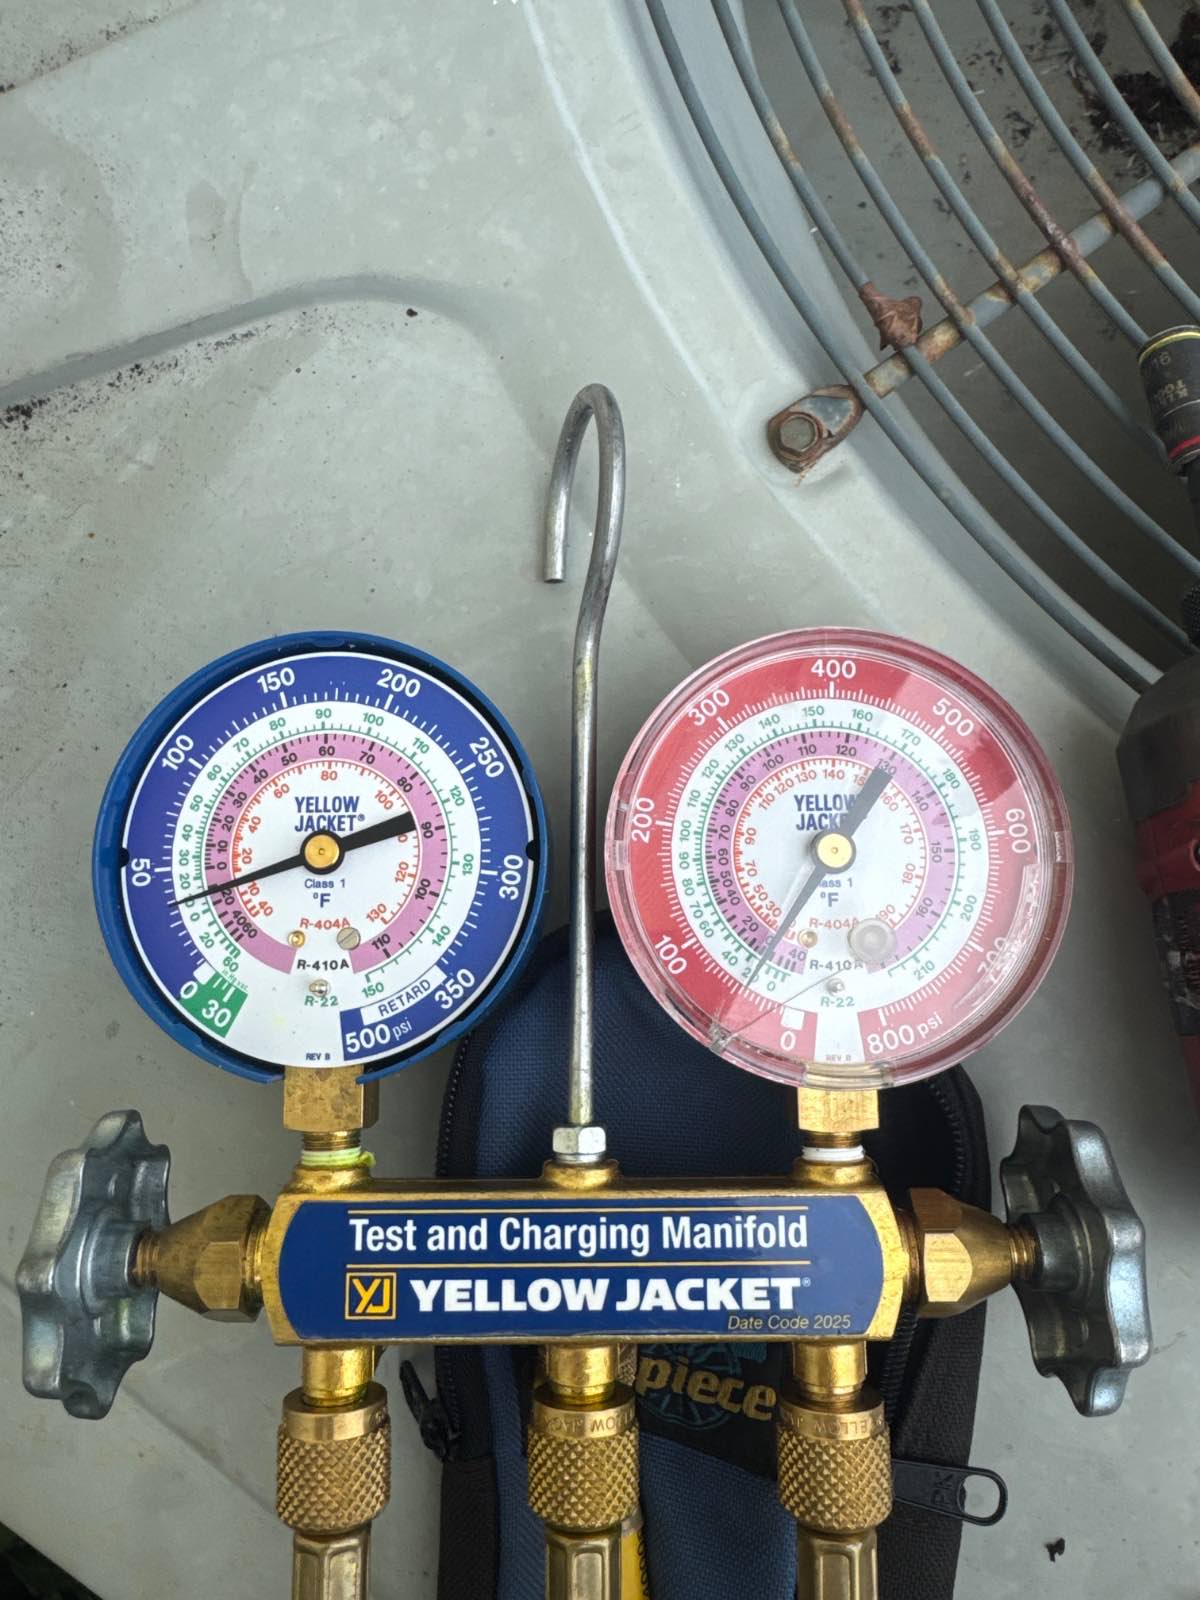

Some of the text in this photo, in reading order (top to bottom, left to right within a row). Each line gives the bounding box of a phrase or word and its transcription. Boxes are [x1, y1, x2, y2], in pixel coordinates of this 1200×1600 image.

[811, 659, 857, 678] 400
[315, 709, 332, 719] 90
[688, 689, 730, 727] 300
[802, 705, 825, 717] 150
[852, 708, 873, 722] 160
[269, 717, 287, 731] 80
[362, 713, 384, 726] 100
[758, 713, 781, 730] 140
[932, 698, 975, 737] 500
[233, 738, 250, 753] 70
[412, 737, 430, 754] 110
[724, 733, 745, 753] 130
[901, 728, 921, 746] 170
[281, 752, 298, 767] 50
[318, 745, 335, 756] 60
[359, 751, 375, 765] 70
[799, 745, 817, 756] 110
[836, 745, 857, 757] 120
[702, 759, 720, 779] 120
[762, 754, 784, 772] 100
[206, 764, 223, 781] 60
[253, 768, 269, 785] 40
[320, 771, 338, 781] 80
[794, 771, 817, 783] 130
[822, 769, 845, 780] 140
[943, 768, 961, 790] 180
[273, 783, 290, 799] 60
[396, 776, 414, 793] 80
[740, 775, 757, 791] 90
[773, 780, 794, 795] 120
[190, 794, 204, 813] 50
[233, 791, 248, 809] 30
[294, 796, 360, 813] YELLOW
[374, 789, 393, 810] 100
[449, 785, 465, 806] 120
[687, 789, 701, 808] 110
[759, 793, 775, 811] 110
[912, 790, 929, 812] 140
[725, 800, 740, 817] 80
[221, 815, 235, 833] 20
[248, 816, 261, 834] 40
[631, 797, 655, 843] 200
[182, 824, 193, 842] 40
[421, 821, 434, 839] 90
[680, 819, 692, 843] 100
[719, 824, 730, 841] 70
[745, 827, 756, 845] 90
[900, 823, 914, 844] 170
[1006, 808, 1031, 854] 600
[217, 840, 228, 853] 10
[969, 829, 982, 851] 190
[131, 667, 524, 1053] 30 0 50 100 150 200 250 300 350 500 psi
[179, 849, 189, 866] 30
[242, 848, 252, 865] 20
[679, 851, 690, 870] 90
[718, 848, 729, 866] 60
[931, 841, 943, 863] 150
[395, 861, 409, 884] 120
[462, 853, 474, 876] 130
[745, 860, 757, 877] 70
[902, 863, 916, 884] 180
[180, 873, 191, 890] 20
[304, 879, 346, 889] Class 1
[682, 877, 695, 896] 80
[720, 871, 732, 888] 50
[414, 878, 431, 901] 100
[727, 889, 740, 906] 40
[753, 884, 768, 901] 50
[258, 901, 273, 916] 40
[366, 903, 387, 924] 130
[689, 901, 703, 919] 70
[765, 900, 782, 917] 30
[916, 897, 934, 919] 160
[960, 895, 977, 922] 200
[299, 917, 351, 930] R-404A
[699, 920, 715, 938] 60
[742, 915, 759, 933] 20
[199, 932, 215, 949] 20
[371, 933, 391, 951] 110
[431, 925, 450, 947] 140
[655, 934, 688, 975] 100
[721, 950, 738, 966] 40
[223, 956, 239, 972] 60
[297, 959, 350, 971] R-410A
[913, 959, 936, 981] 210
[362, 982, 385, 998] 150
[378, 979, 431, 1018] RETARD
[304, 995, 339, 1007] R-22
[820, 996, 855, 1008] R-22
[917, 1011, 943, 1038] psi
[780, 1030, 796, 1051] 0
[867, 1024, 915, 1054] 800
[306, 1053, 323, 1061] REV
[349, 1215, 808, 1257] Test and Charging Manifold
[409, 1278, 610, 1312] YELLOW
[728, 1314, 851, 1330] Date Code 2025
[635, 1356, 777, 1421] piece
